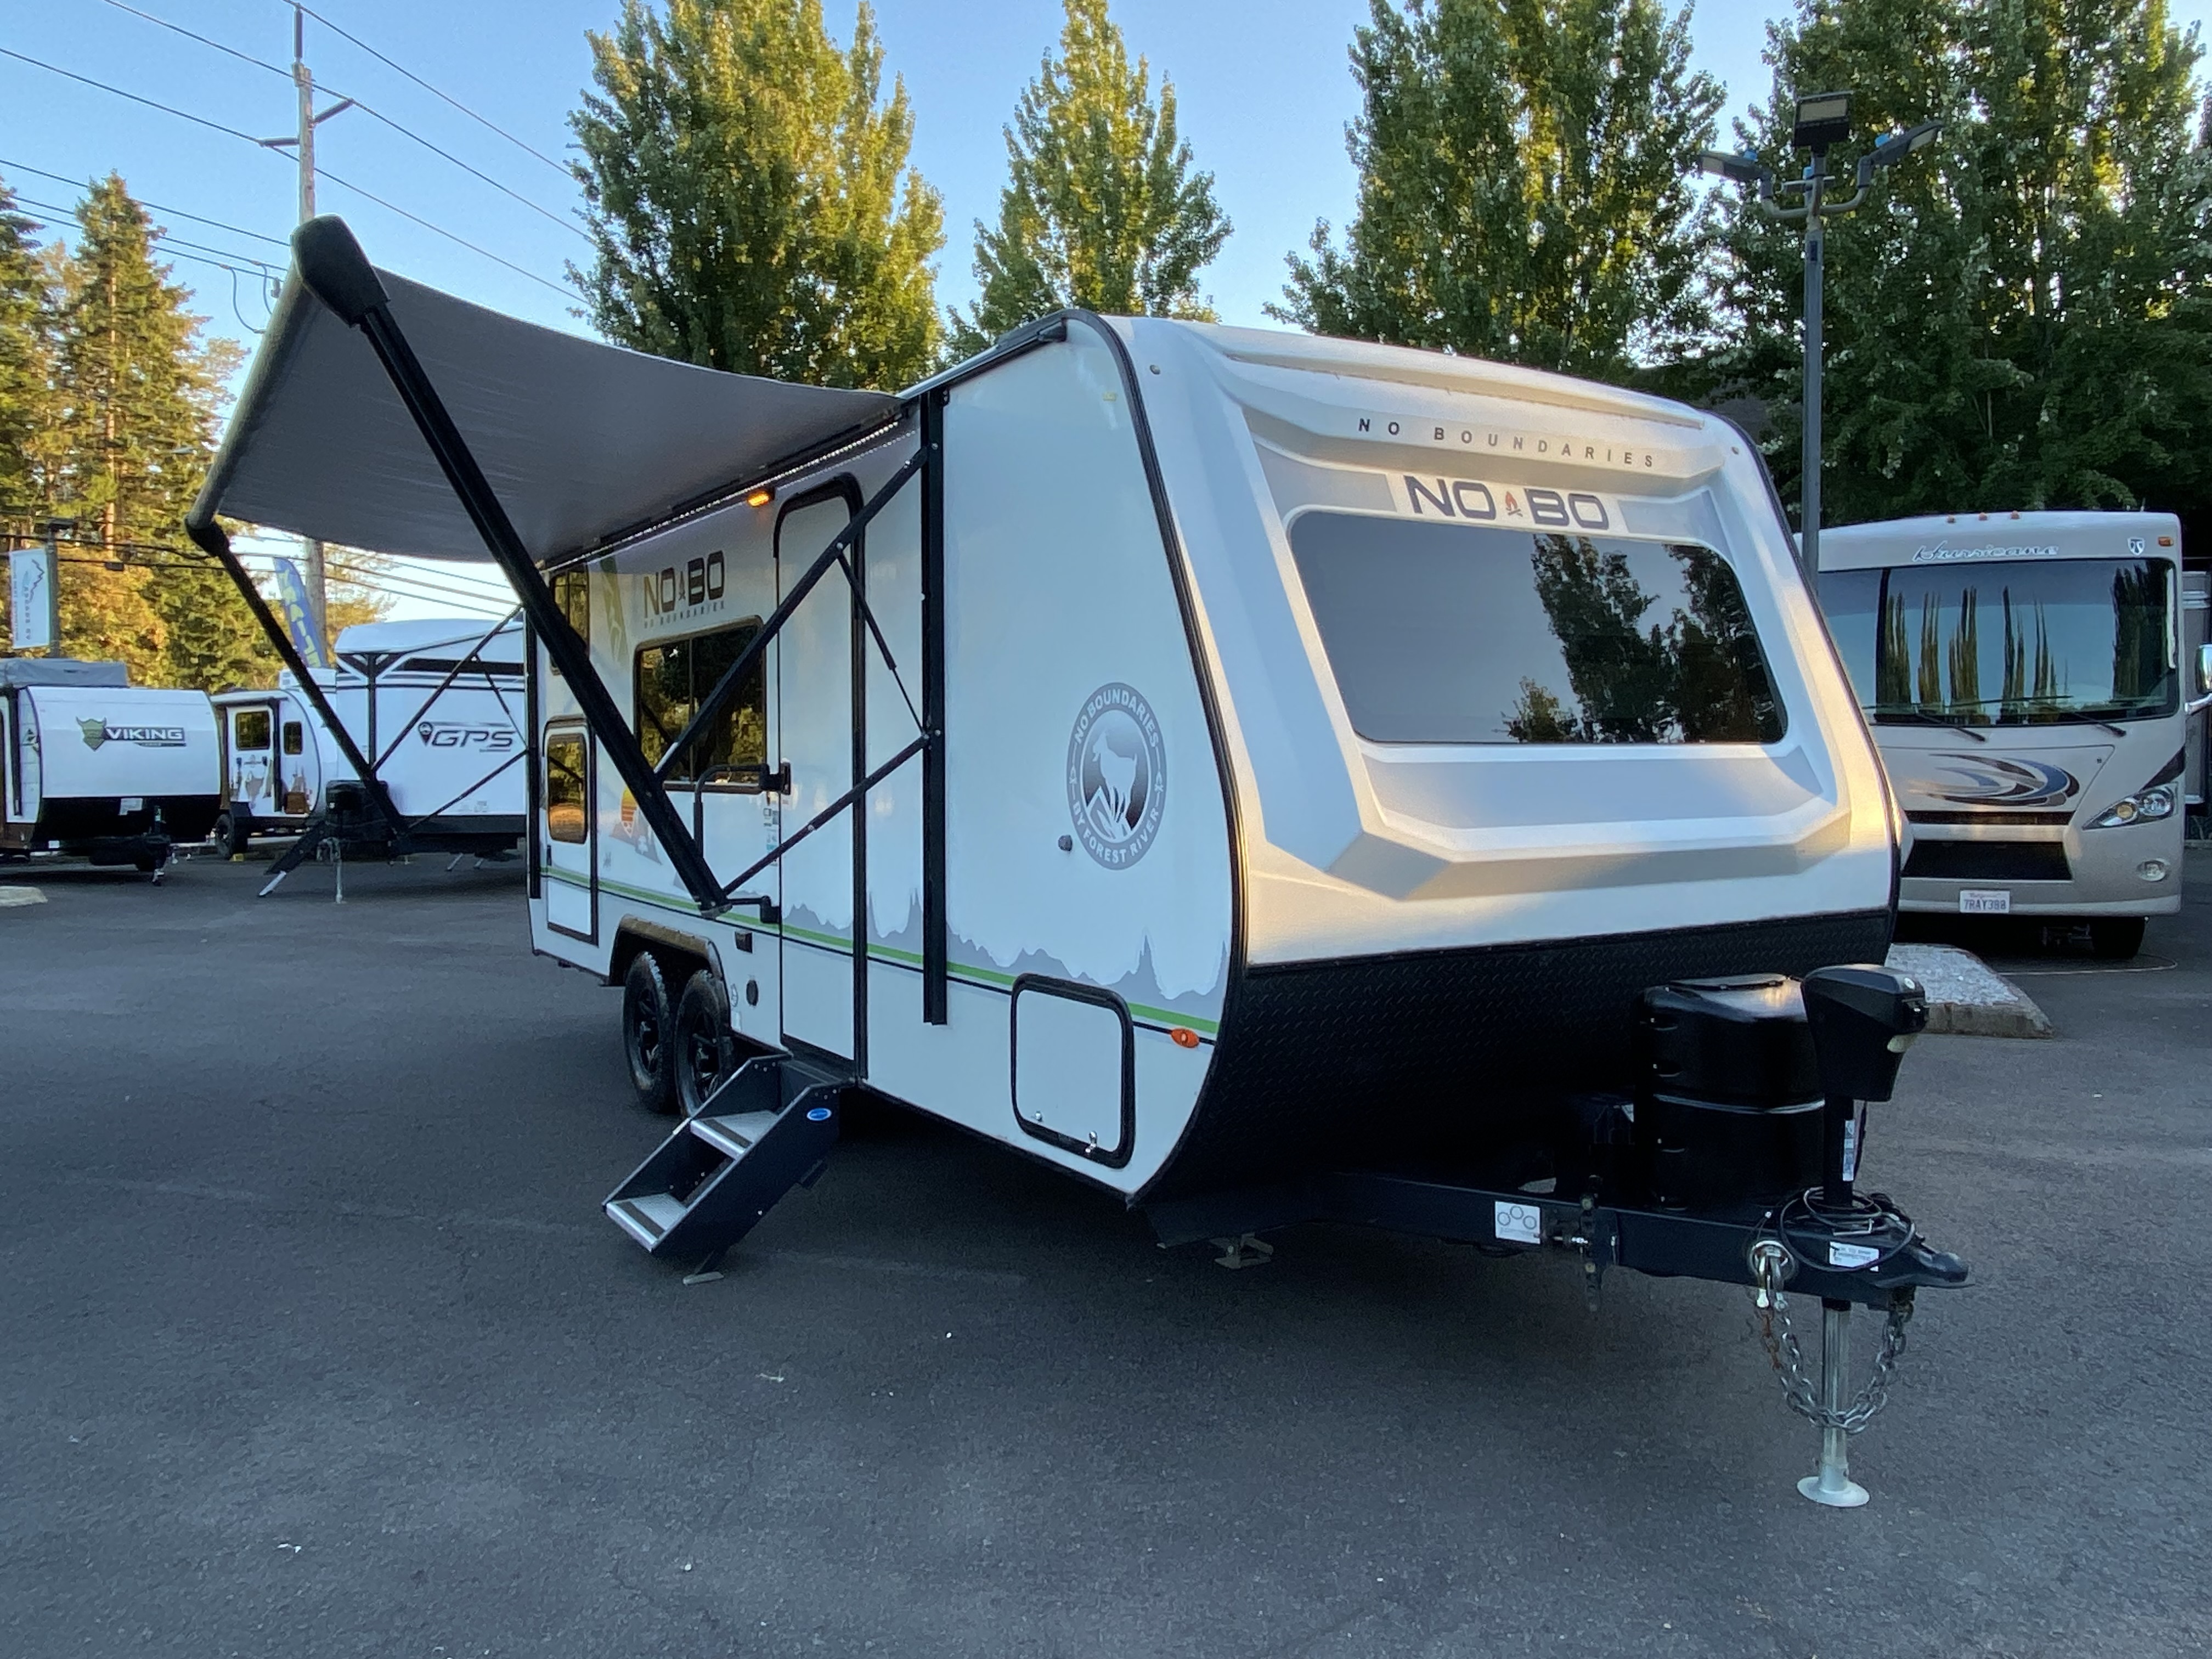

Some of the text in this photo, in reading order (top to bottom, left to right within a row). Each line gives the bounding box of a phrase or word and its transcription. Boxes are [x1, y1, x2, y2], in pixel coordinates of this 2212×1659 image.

[1358, 418, 1652, 467] NO BOUNDARIES
[1912, 540, 2058, 562] Hurricane
[105, 729, 183, 740] VIKING
[1074, 689, 1159, 747] NO BOUNDARIES
[432, 730, 516, 747] GPS
[1073, 801, 1159, 864] BY FOREST RIVER
